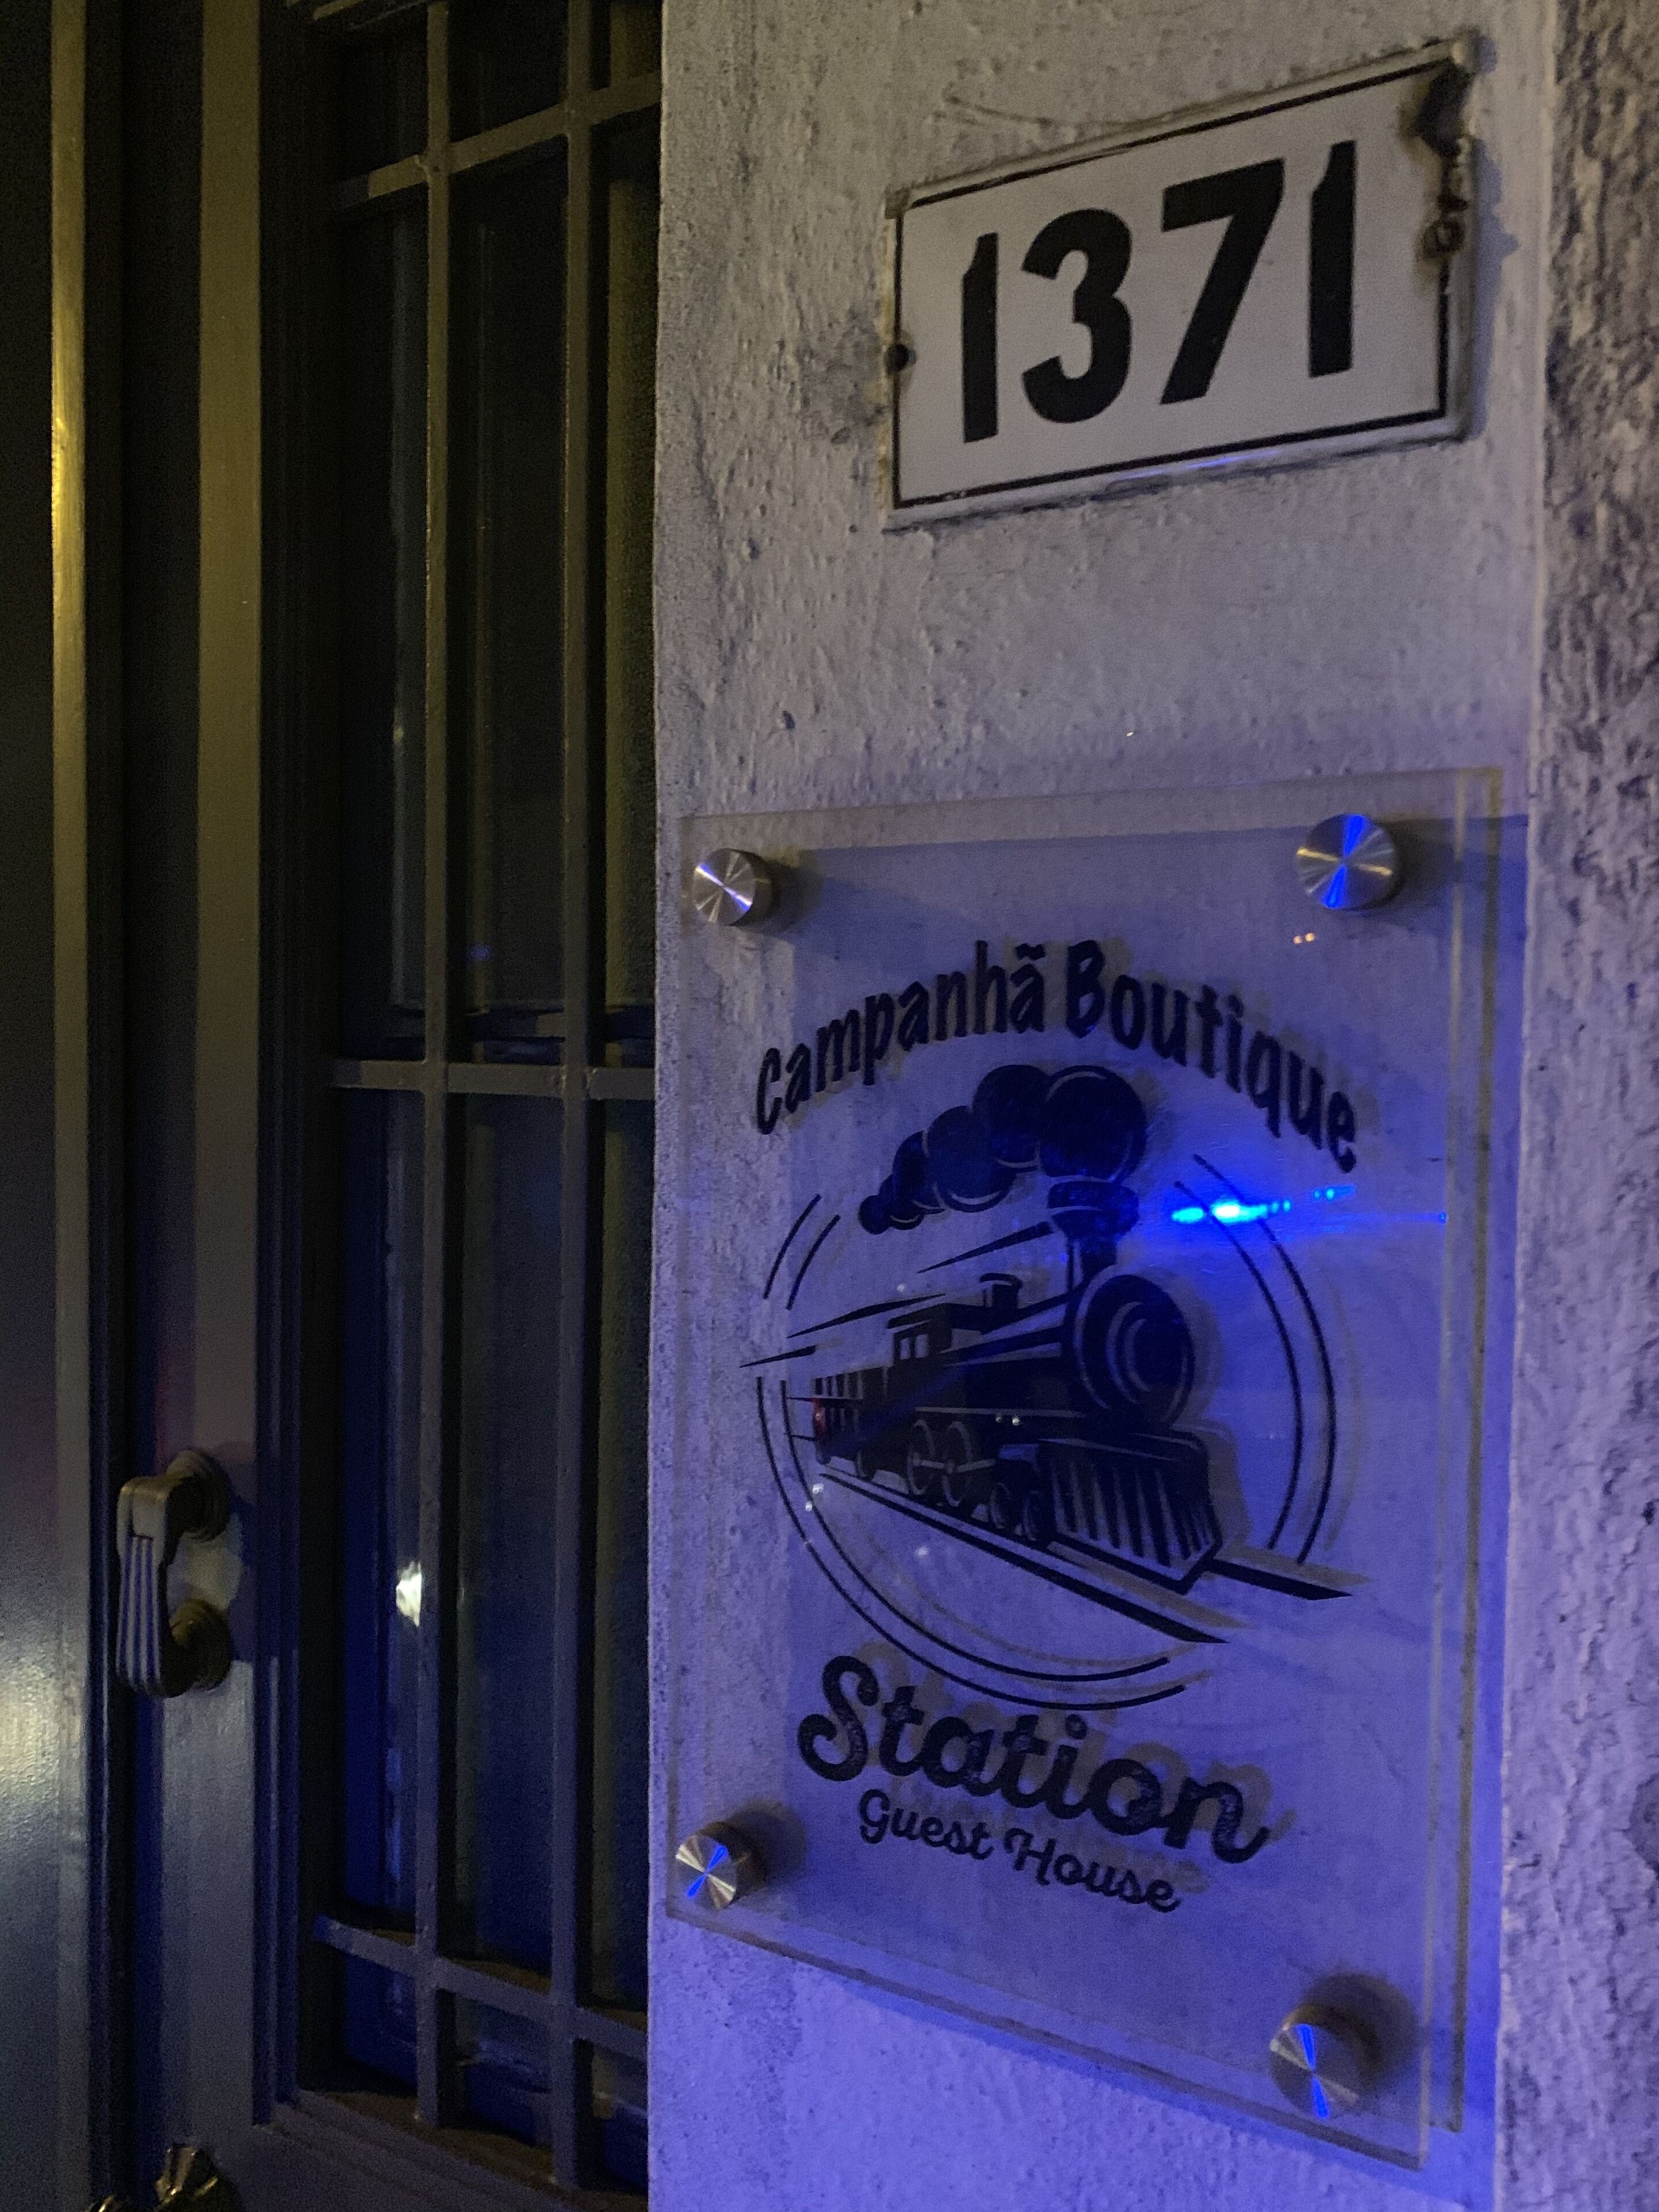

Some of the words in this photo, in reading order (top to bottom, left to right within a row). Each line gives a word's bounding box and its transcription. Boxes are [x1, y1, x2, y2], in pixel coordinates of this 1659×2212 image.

[961, 139, 1357, 444] 1371
[756, 939, 1046, 1135] Campanhã
[1064, 939, 1358, 1173] Boutique
[797, 1654, 1271, 1863] Station
[858, 1788, 995, 1861] Guest
[1003, 1827, 1181, 1913] House
